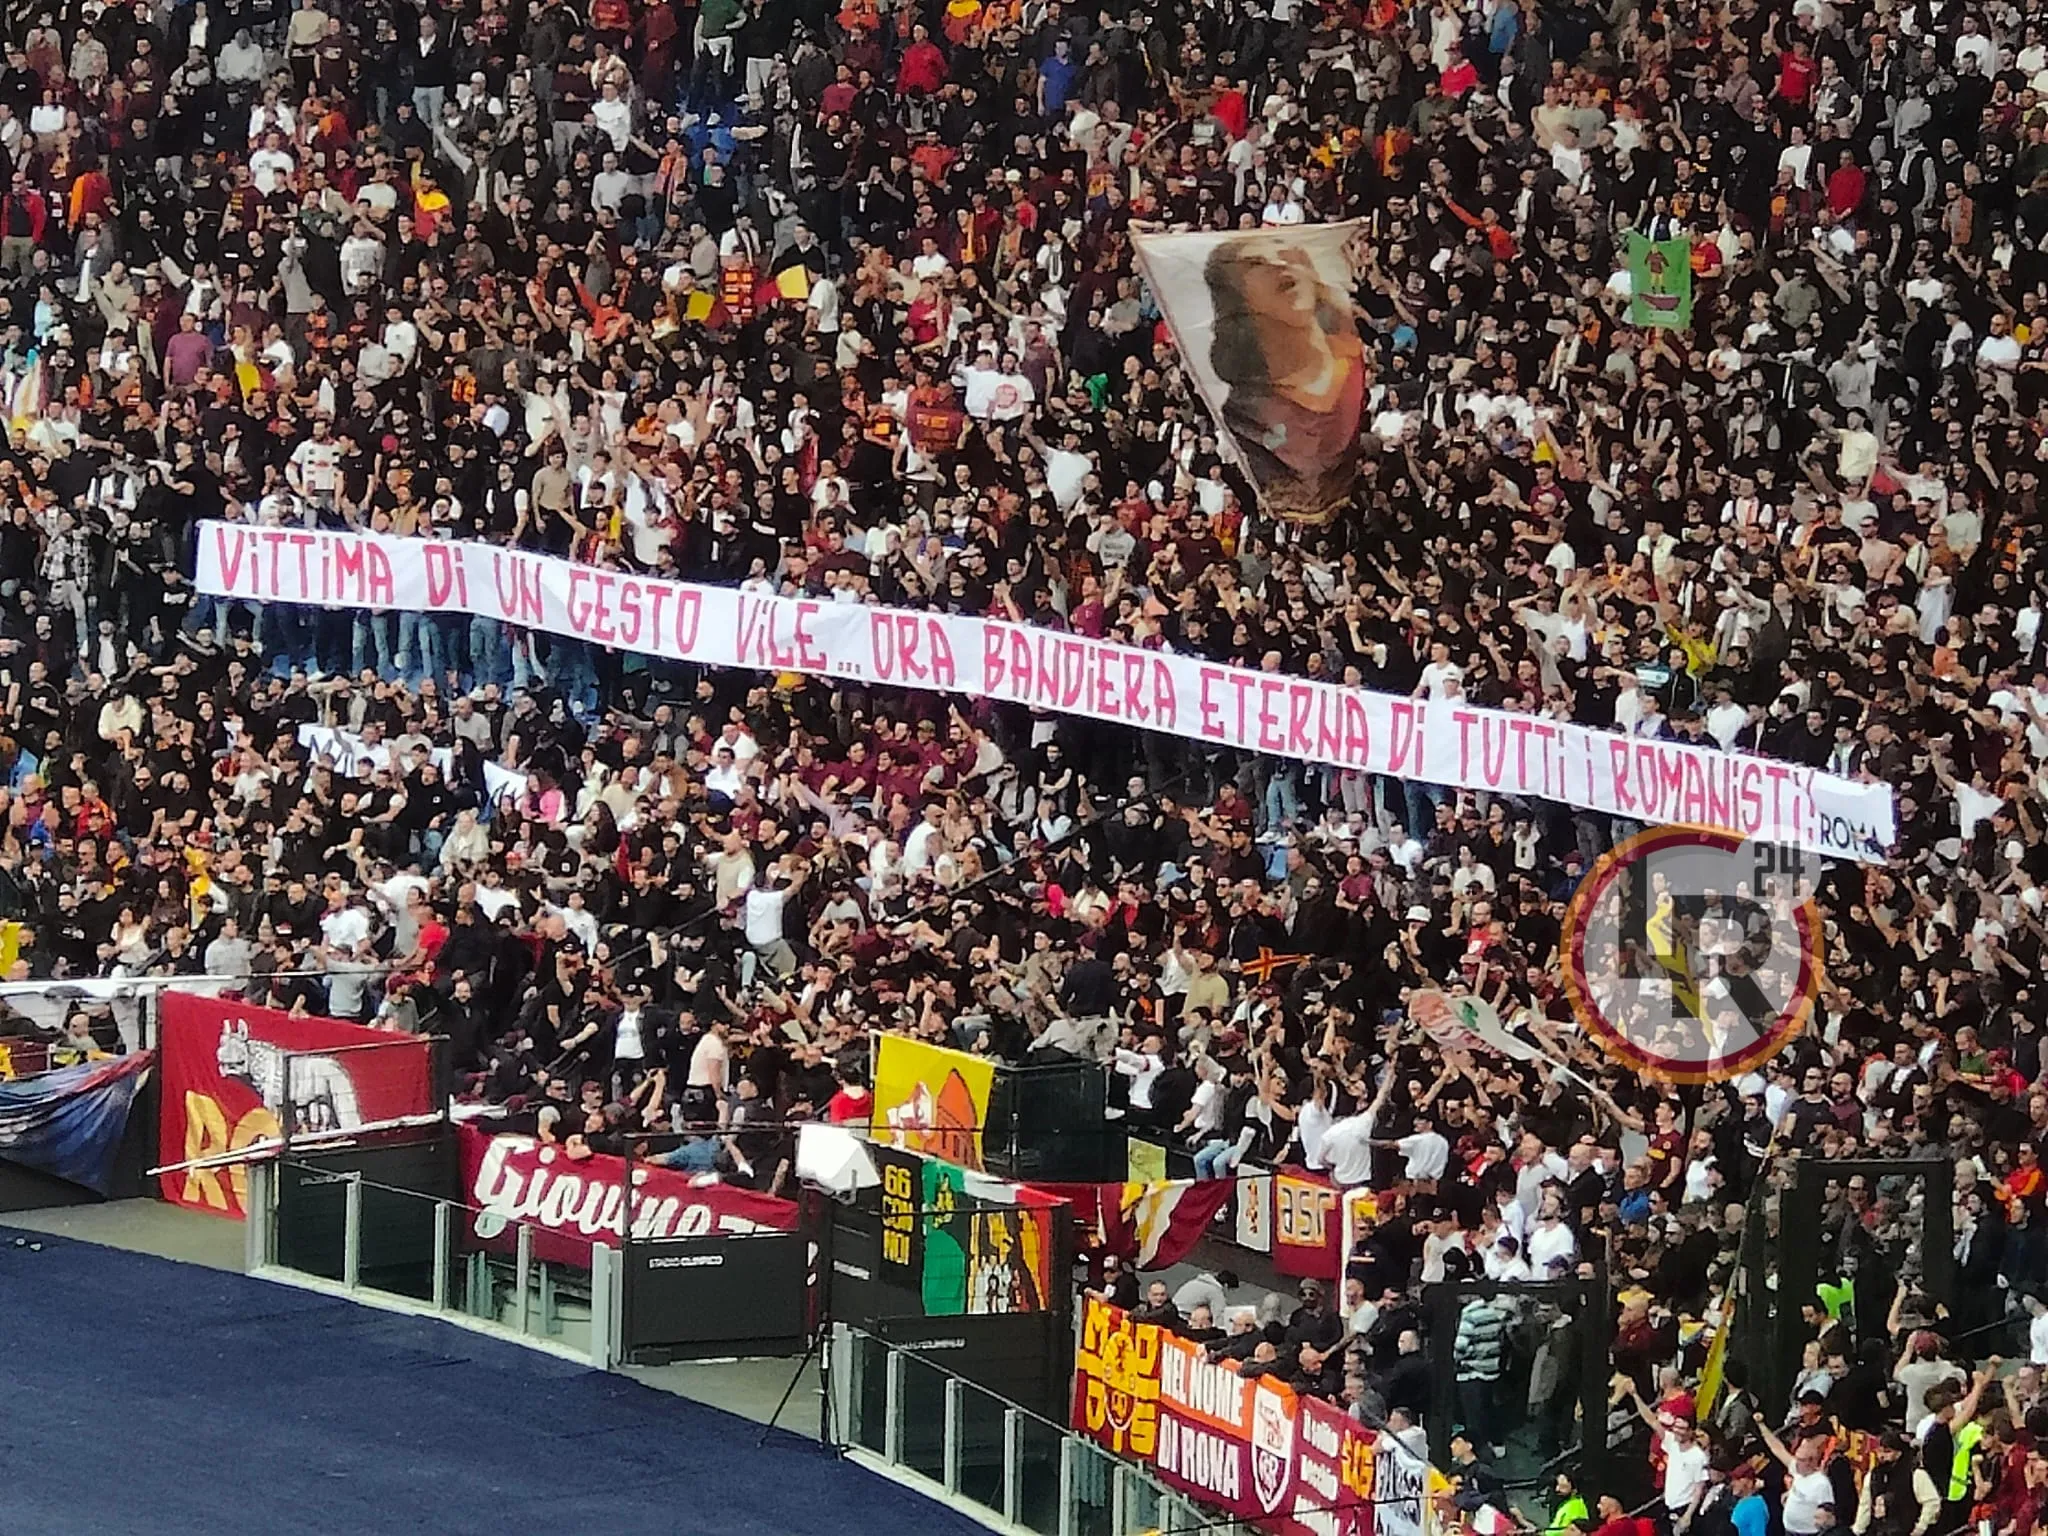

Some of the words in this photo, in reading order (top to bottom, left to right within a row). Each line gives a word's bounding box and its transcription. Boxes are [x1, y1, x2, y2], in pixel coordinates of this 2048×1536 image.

[493, 553, 543, 625] UN
[566, 570, 703, 657] GESTO
[870, 612, 956, 687] ORA
[1199, 667, 1371, 767] ETERNA
[884, 1164, 912, 1200] 66
[1160, 1341, 1187, 1406] NEL
[1189, 1355, 1246, 1428] NOME
[1157, 1412, 1180, 1473] DI
